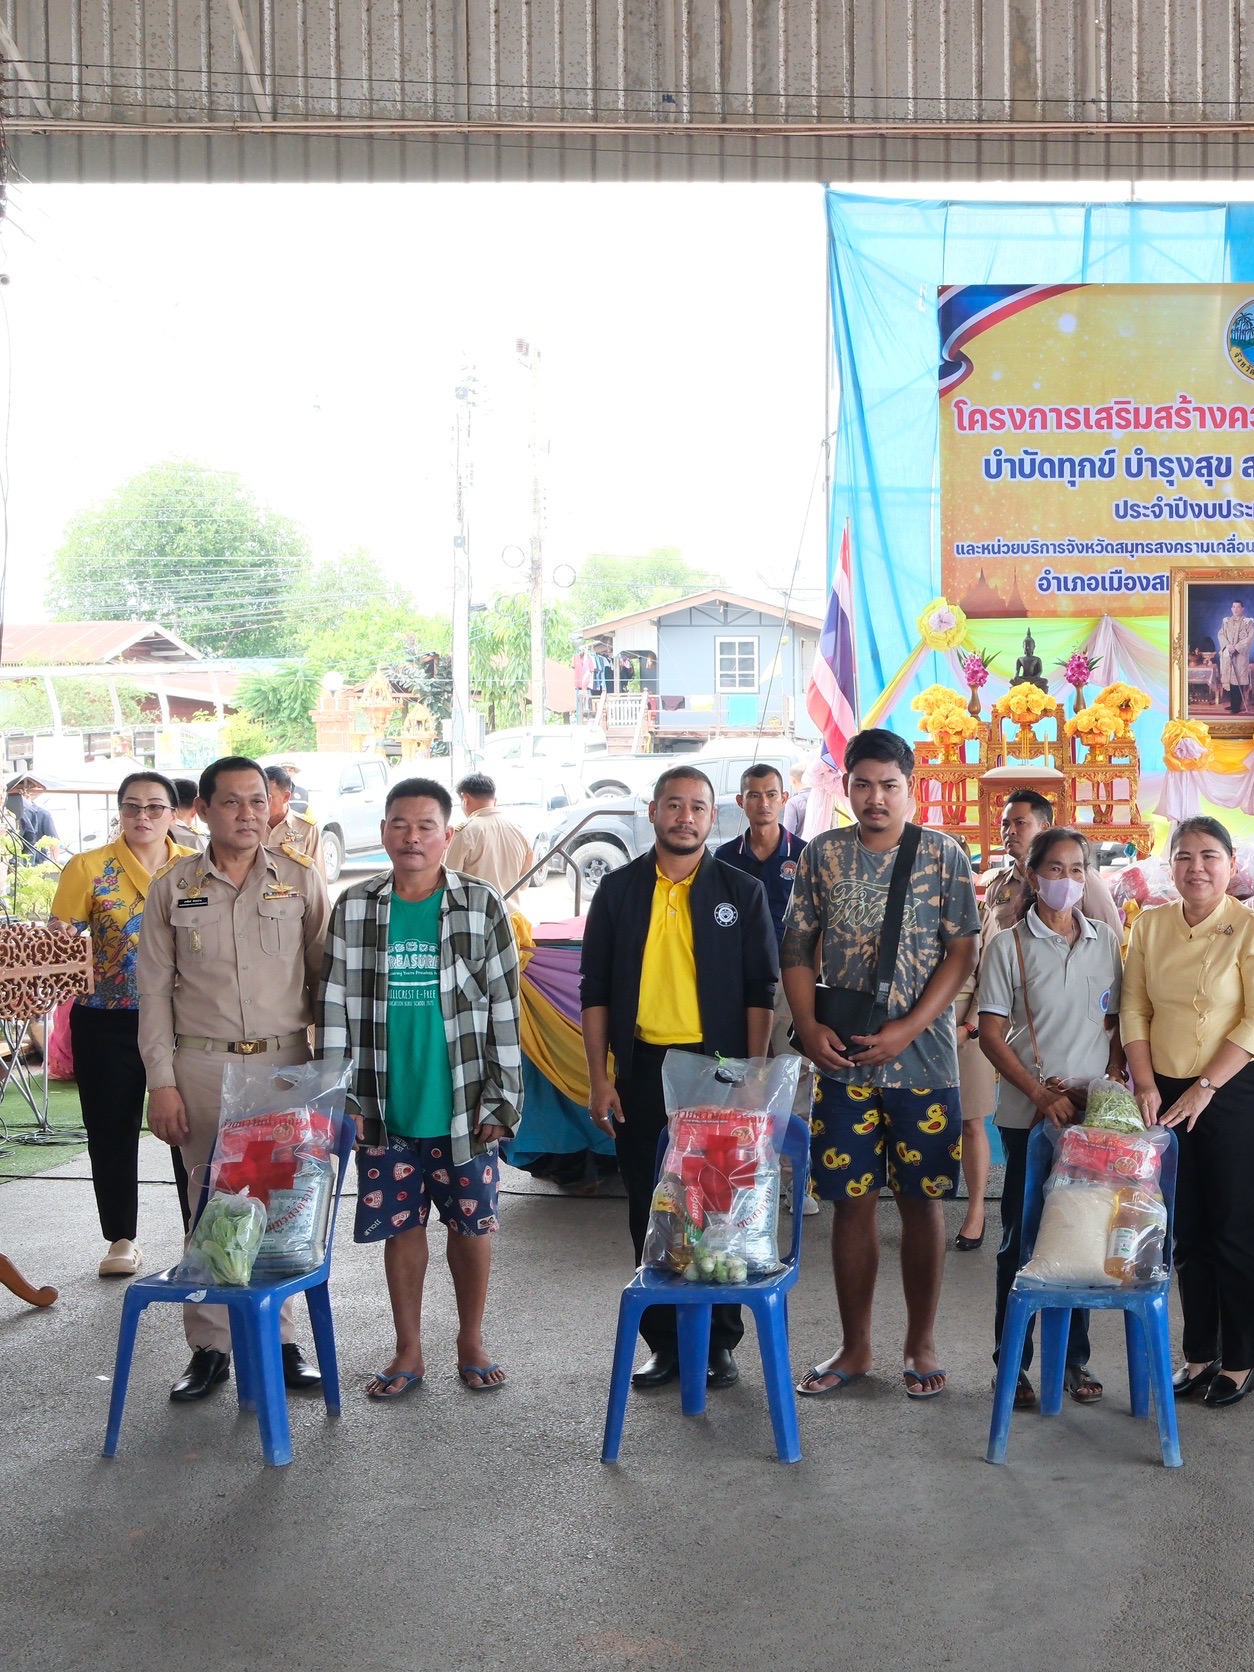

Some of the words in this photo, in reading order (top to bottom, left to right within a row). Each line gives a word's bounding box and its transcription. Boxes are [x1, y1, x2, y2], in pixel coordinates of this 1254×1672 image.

[983, 447, 1117, 488] บำบัดทุกข์
[1124, 447, 1232, 487] บำรุงสุข
[388, 953, 440, 969] REASURE
[388, 989, 414, 1000] ILLCREST
